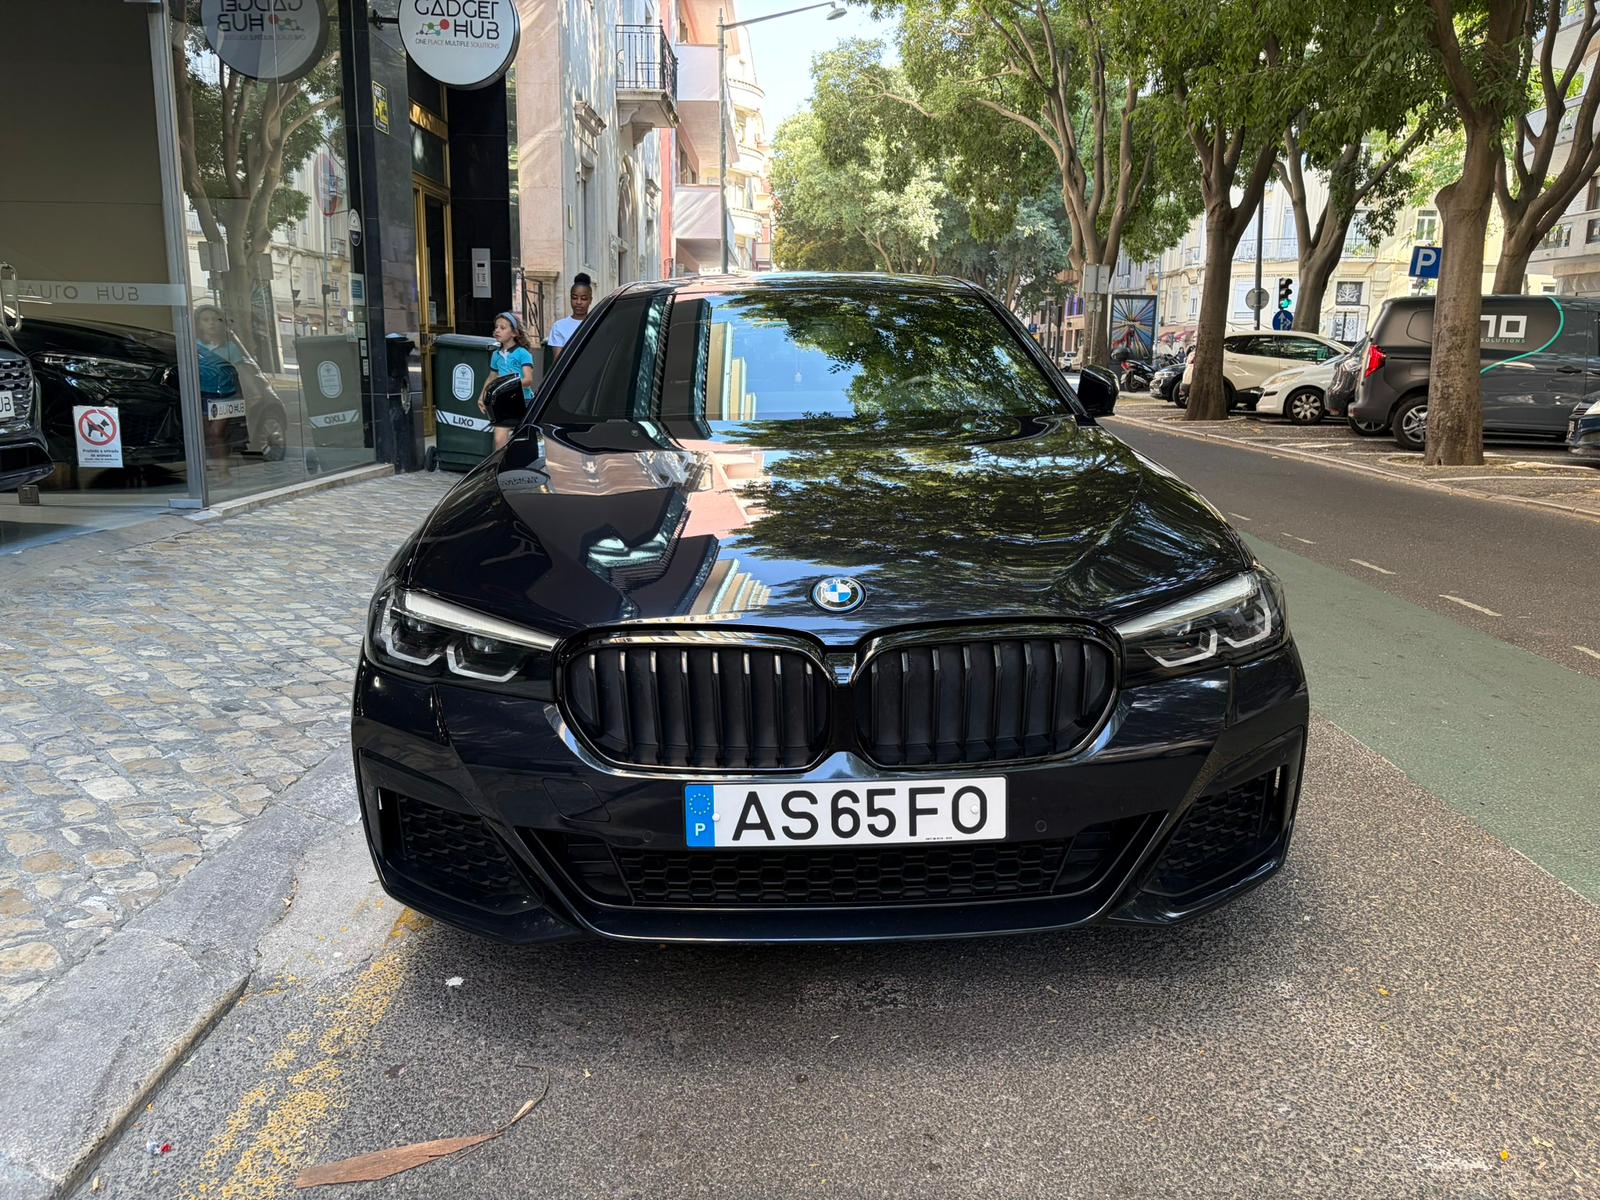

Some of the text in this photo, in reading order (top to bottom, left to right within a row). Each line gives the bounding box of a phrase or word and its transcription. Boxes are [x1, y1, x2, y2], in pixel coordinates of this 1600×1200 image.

[414, 0, 499, 19] GADGET
[454, 19, 500, 40] HUB
[1415, 248, 1437, 276] P
[96, 286, 139, 301] HUB
[453, 415, 474, 427] LIXO
[732, 785, 988, 841] AS65FO
[695, 823, 706, 836] P
